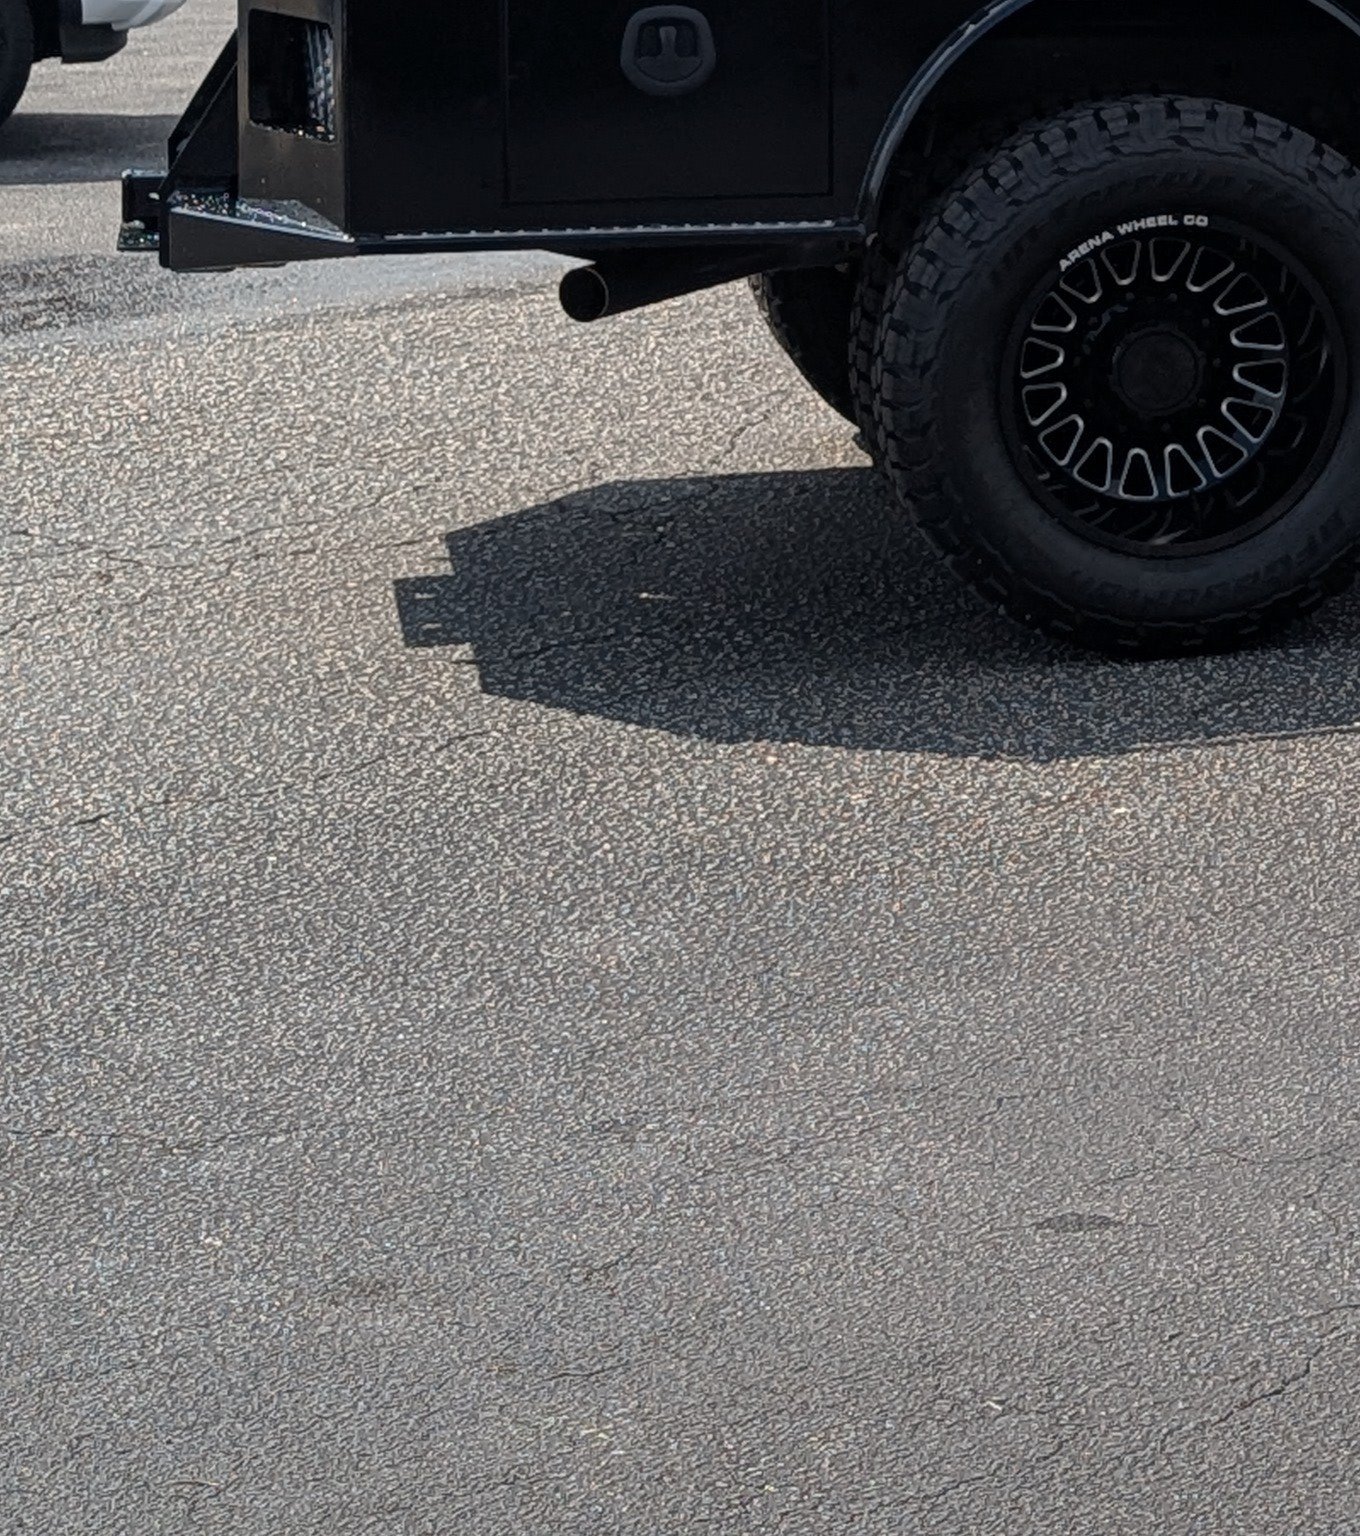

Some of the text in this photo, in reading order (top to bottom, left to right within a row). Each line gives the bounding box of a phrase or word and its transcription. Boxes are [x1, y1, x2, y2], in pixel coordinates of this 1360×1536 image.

[1059, 214, 1209, 272] ARENA WHEEL CO
